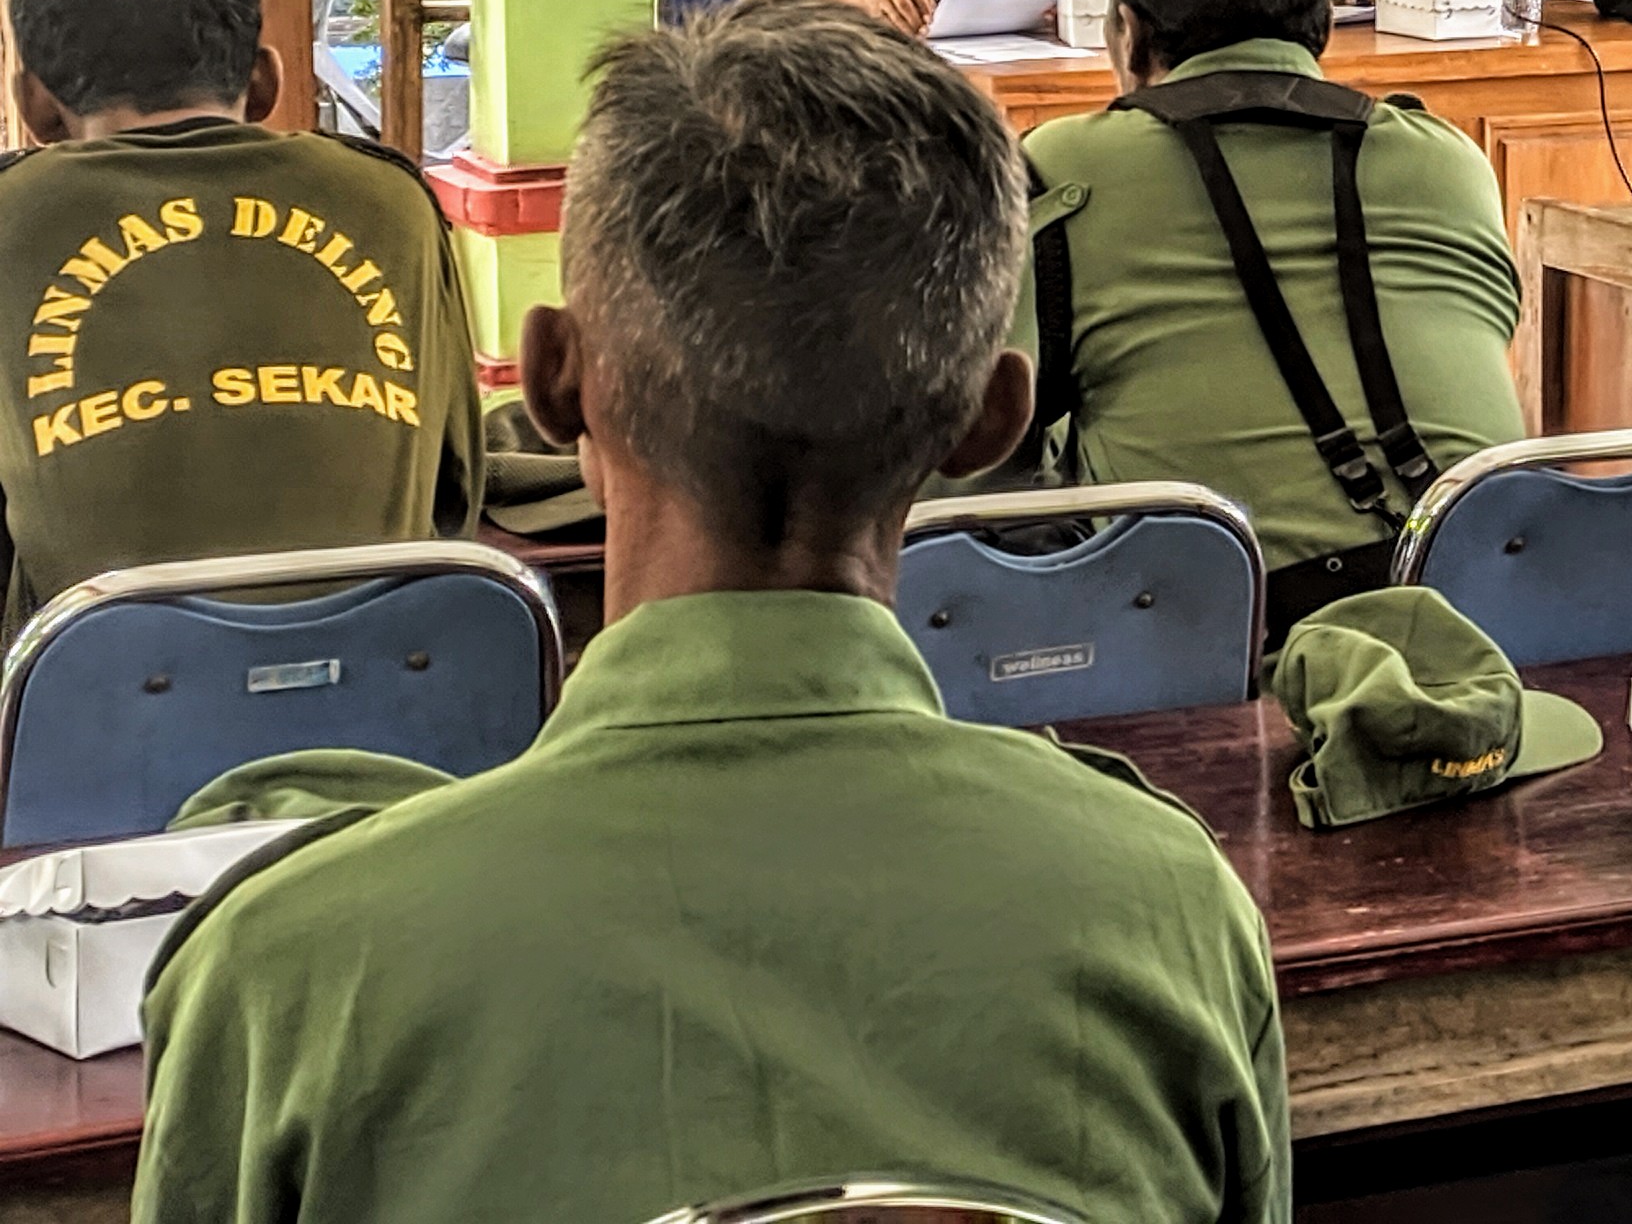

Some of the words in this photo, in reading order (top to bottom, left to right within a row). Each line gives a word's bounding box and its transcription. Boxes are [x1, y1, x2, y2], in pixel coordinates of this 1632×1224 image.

[28, 197, 205, 398] LINMAS
[229, 195, 414, 372] DELING
[32, 380, 191, 457] KEC.
[212, 365, 421, 428] SEKAR
[1431, 747, 1505, 778] LINMAS
